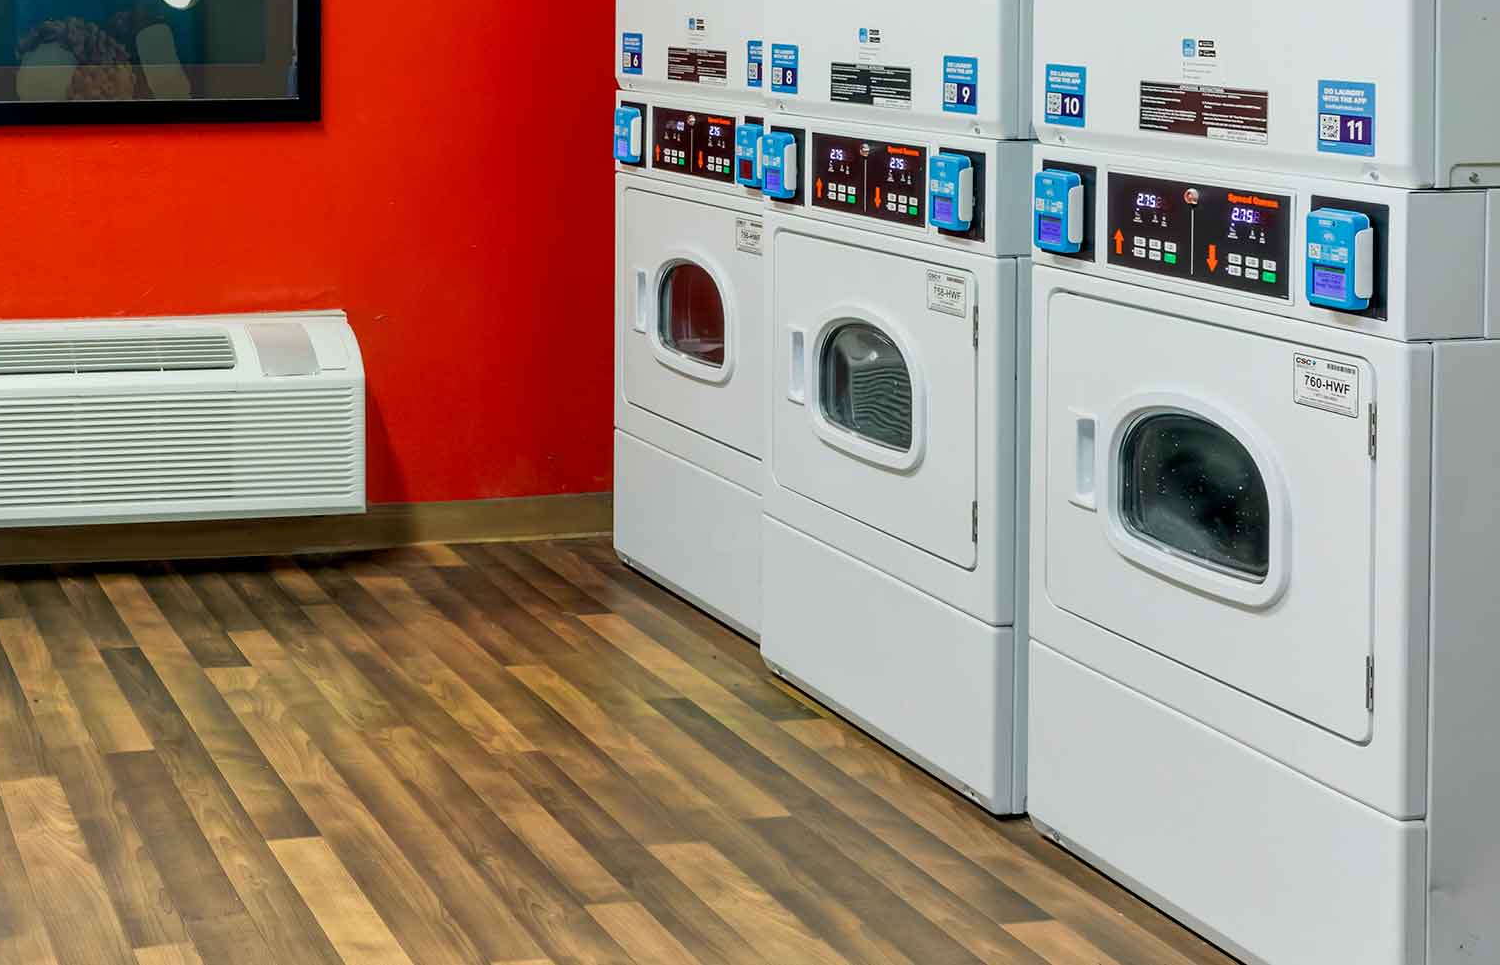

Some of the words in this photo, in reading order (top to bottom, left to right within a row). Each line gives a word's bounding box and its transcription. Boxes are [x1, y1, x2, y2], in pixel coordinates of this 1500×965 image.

[633, 54, 639, 67] 6
[786, 70, 793, 85] 8
[962, 87, 970, 103] 9
[1064, 96, 1080, 115] 10
[1347, 119, 1363, 141] 11
[1295, 356, 1312, 366] CSC
[1304, 374, 1351, 395] 760-HWF
